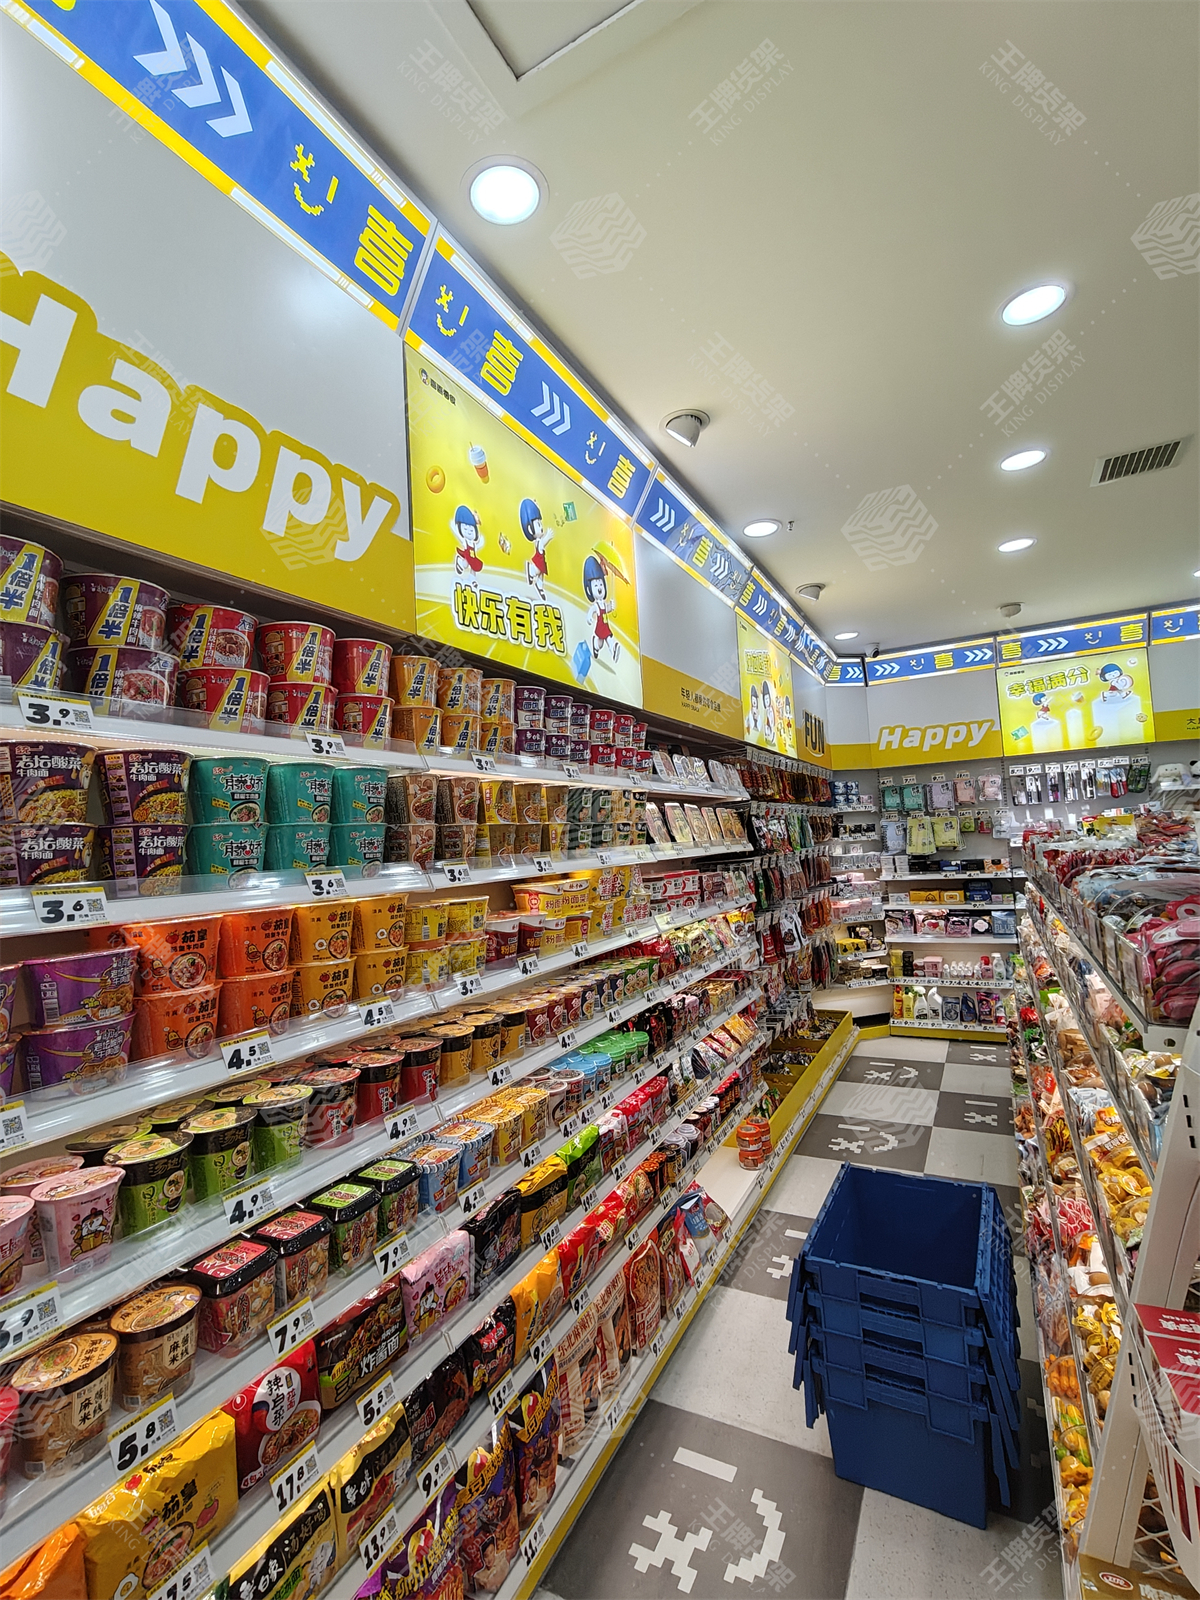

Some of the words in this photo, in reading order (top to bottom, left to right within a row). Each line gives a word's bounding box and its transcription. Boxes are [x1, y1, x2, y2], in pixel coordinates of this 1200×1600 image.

[354, 204, 414, 296] 喜
[480, 329, 523, 396] 喜
[0, 293, 392, 562] Happy
[607, 454, 636, 498] 喜
[0, 552, 38, 611] 1倍半
[98, 586, 134, 640] 1倍半
[126, 604, 144, 644] 麻辣牛肉面
[455, 584, 566, 654] 快乐有我
[182, 614, 208, 663] 1倍半
[203, 627, 218, 665] 红烧牛肉面
[1120, 623, 1144, 642] 喜
[294, 631, 319, 675] 1倍半
[934, 652, 954, 669] 喜
[1001, 641, 1022, 659] 喜
[362, 649, 383, 688] 1倍半
[408, 662, 427, 700] 1倍半
[1007, 665, 1090, 698] 幸福满分
[218, 676, 247, 725] 1倍半
[448, 673, 464, 709] 1倍半
[485, 683, 501, 717] 1倍半
[26, 703, 70, 726] 3.9
[311, 737, 333, 755] 3.9
[422, 714, 440, 750] 1倍半
[454, 720, 471, 754] 1倍半
[804, 711, 825, 754] FUN
[879, 722, 991, 751] Happy
[16, 755, 82, 770] 老坛酸菜
[16, 769, 49, 778] 牛肉面
[129, 762, 183, 775] 老坛酸菜
[129, 774, 157, 782] 牛肉面
[20, 851, 54, 860] 牛肉面
[21, 837, 84, 852] 老坛酸菜
[138, 836, 185, 849] 老坛酸菜
[138, 848, 165, 856] 牛肉面
[311, 879, 334, 896] 3.6
[447, 868, 463, 883] 3.6
[40, 900, 84, 924] 3.6
[181, 928, 208, 944] 茄皇
[331, 968, 350, 982] 茄皇
[460, 980, 474, 996] 3.9
[363, 1008, 385, 1026] 4.5
[228, 1046, 257, 1070] 4.5
[491, 1069, 505, 1086] 4.9
[390, 1118, 408, 1140] 4.9
[524, 1150, 536, 1167] 4.2
[230, 1194, 259, 1224] 4.9
[464, 1192, 478, 1213] 4.2
[380, 1247, 400, 1275] 7.9
[275, 1318, 300, 1354] 7.9
[360, 1331, 400, 1378] 炸酱面
[266, 1373, 285, 1427] 辣白菜
[286, 1387, 296, 1412] 拉面
[363, 1393, 384, 1426] 5.5
[117, 1421, 156, 1471] 5.8
[276, 1466, 305, 1512] 17.8
[422, 1463, 440, 1498] 9.9
[162, 1478, 199, 1522] 茄皇
[364, 1527, 385, 1570] 13.9
